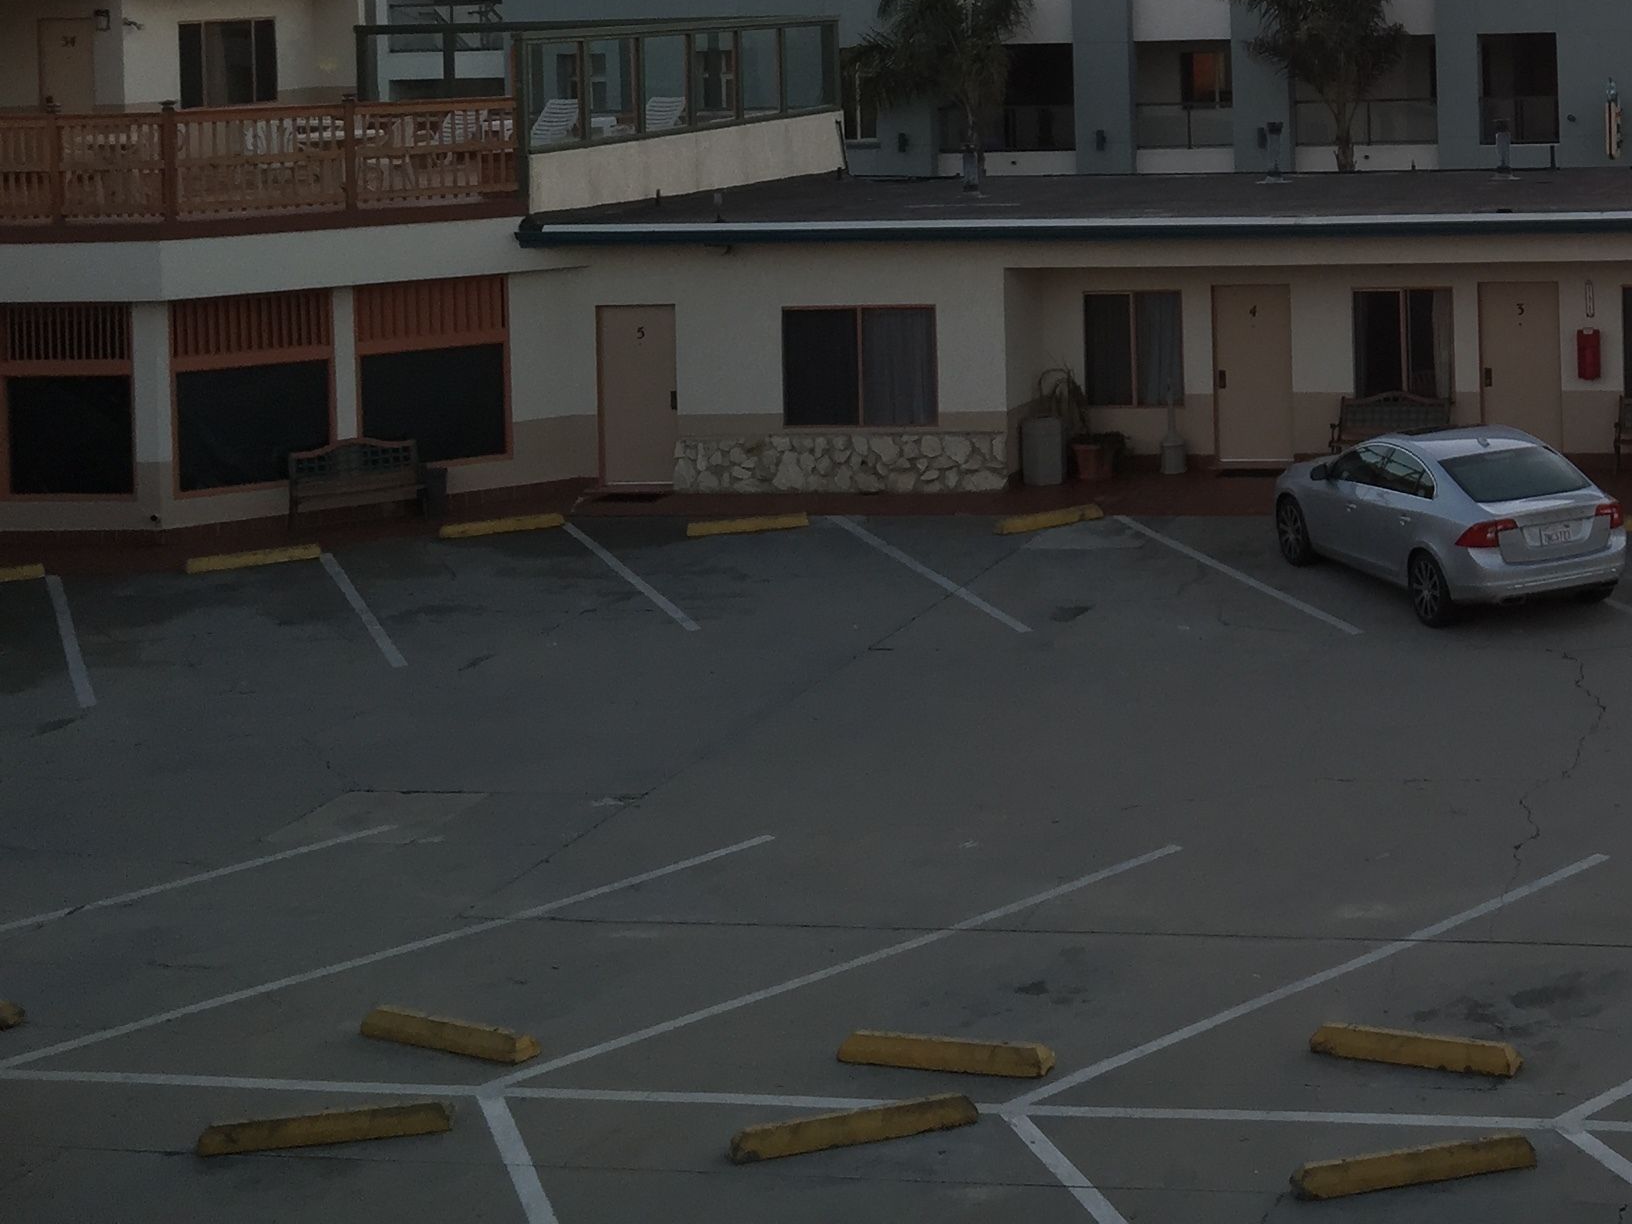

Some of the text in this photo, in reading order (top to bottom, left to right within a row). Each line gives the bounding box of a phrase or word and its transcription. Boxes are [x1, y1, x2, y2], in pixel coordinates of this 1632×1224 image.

[1249, 304, 1257, 317] 4
[1516, 303, 1525, 316] 3
[636, 326, 645, 340] 5
